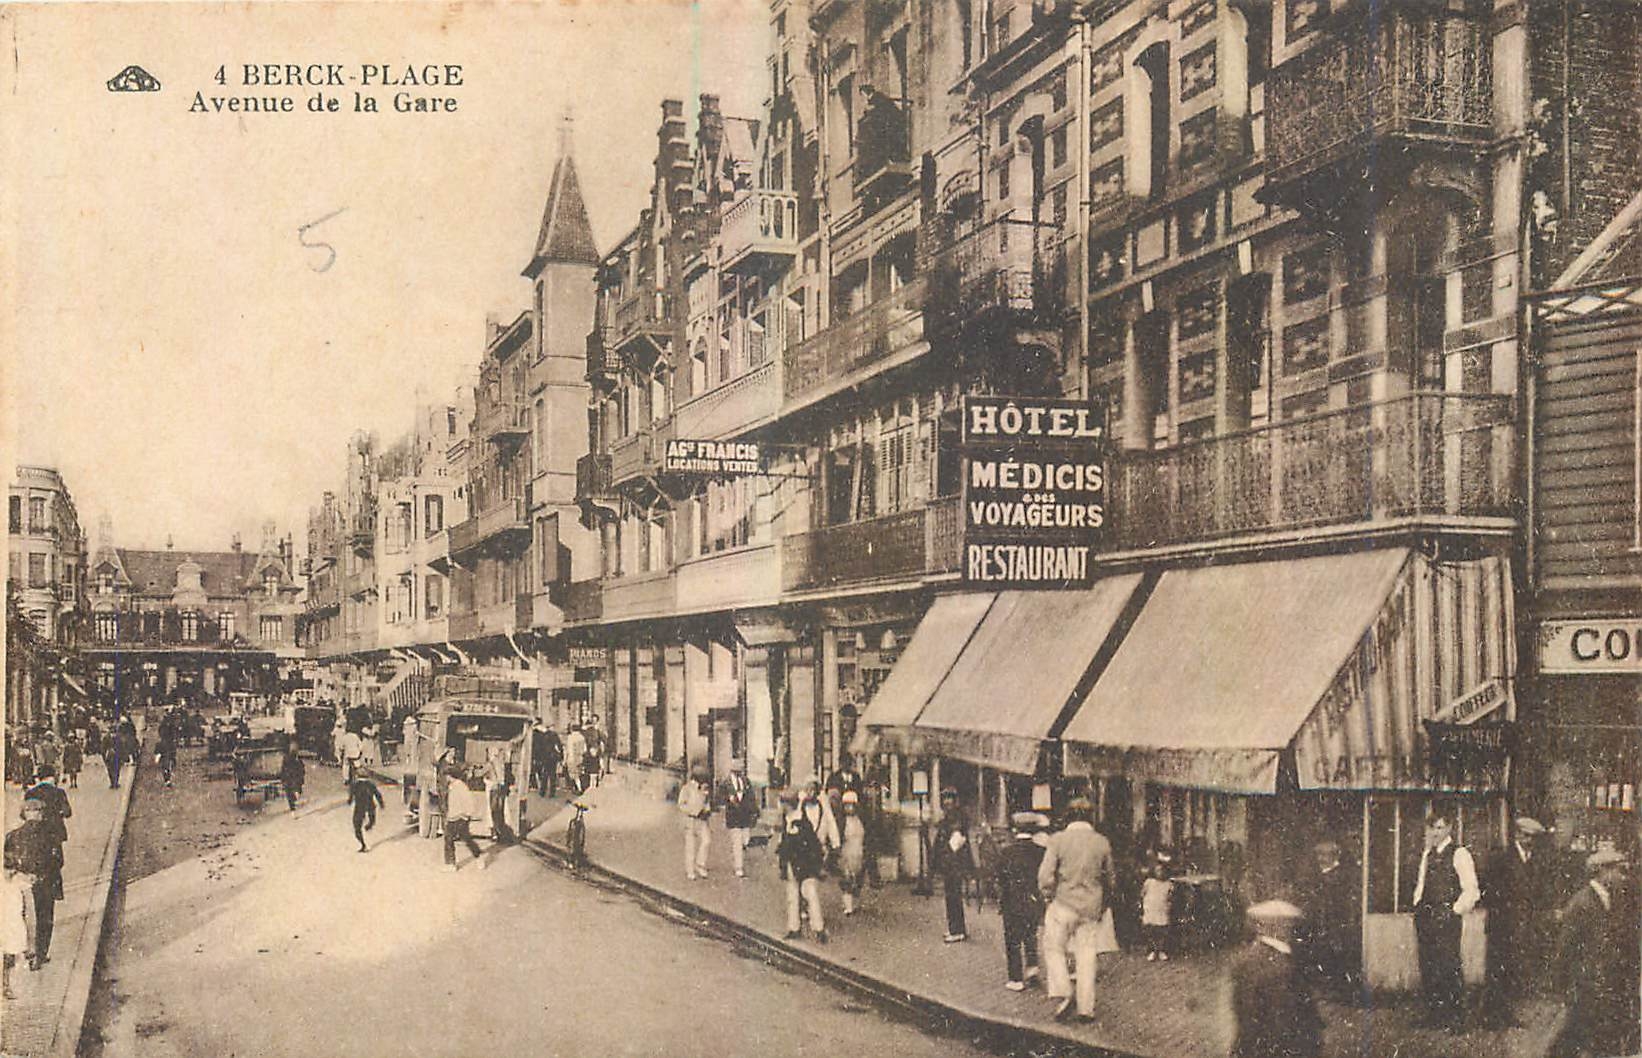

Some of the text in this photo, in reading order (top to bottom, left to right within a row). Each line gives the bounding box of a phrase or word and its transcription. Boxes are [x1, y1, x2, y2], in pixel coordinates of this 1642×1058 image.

[297, 206, 350, 273] 5
[970, 401, 1102, 437] HÔTEL
[667, 459, 720, 471] LOCATIONS
[698, 442, 758, 460] FRANCIS
[972, 457, 1103, 491] MÉDICIS
[971, 501, 1103, 527] VOYAGEURS
[968, 545, 1089, 581] RESTAURANT
[1571, 627, 1642, 660] CO
